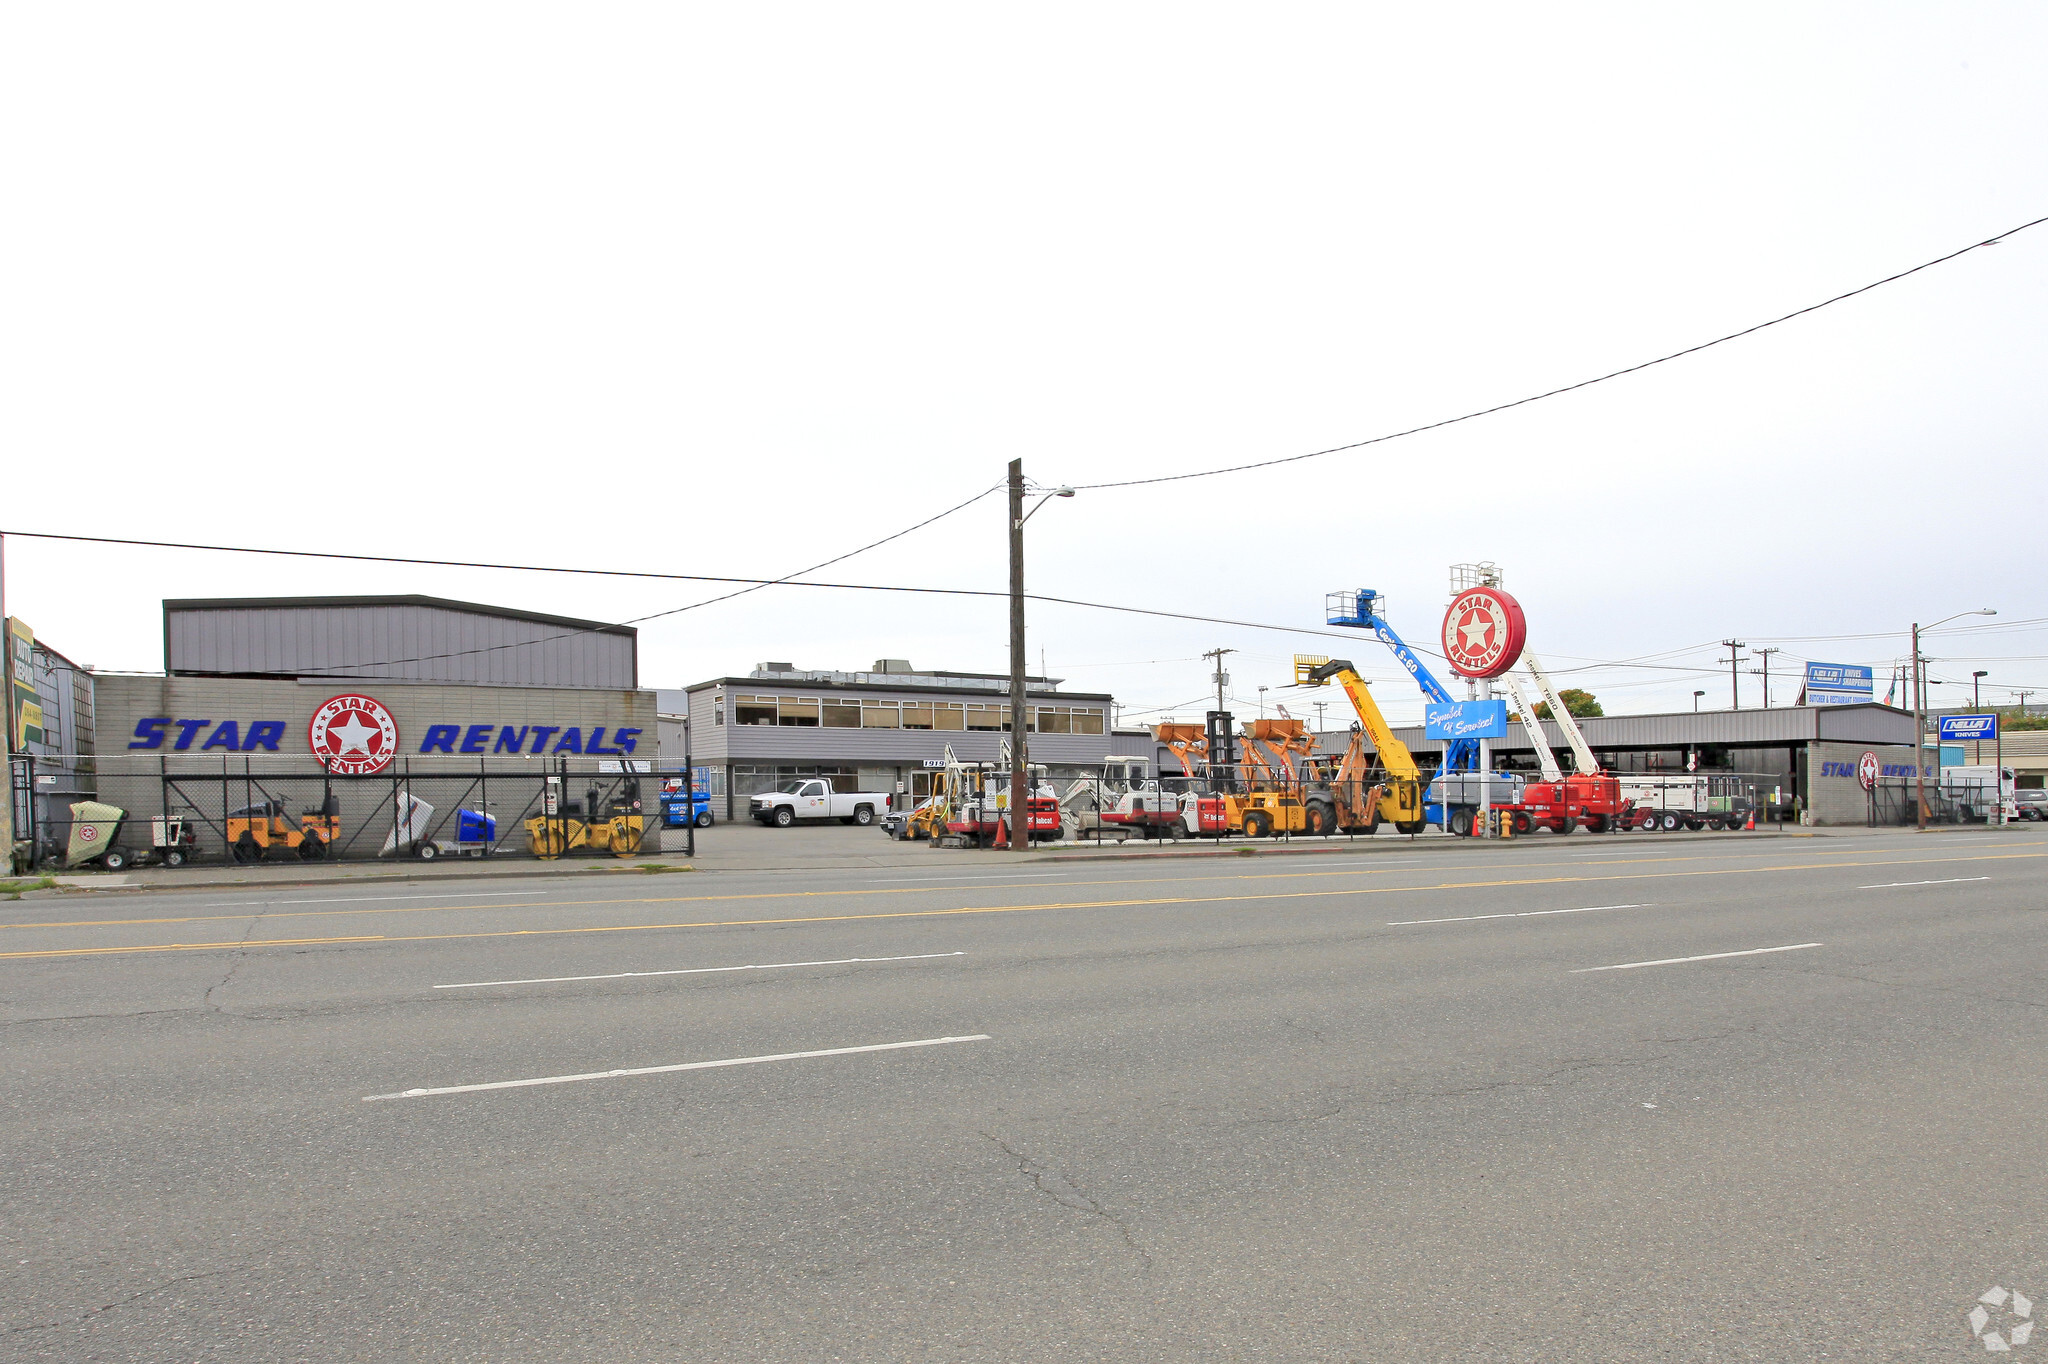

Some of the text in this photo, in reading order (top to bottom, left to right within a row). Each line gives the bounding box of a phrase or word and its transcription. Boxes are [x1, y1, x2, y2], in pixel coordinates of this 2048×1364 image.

[1458, 596, 1493, 614] STAR
[1379, 627, 1418, 673] Genie S-60
[1450, 642, 1501, 668] RENTALS
[327, 698, 378, 715] STAR
[1510, 691, 1526, 715] Snorkel
[1428, 704, 1463, 727] Symbol
[1949, 720, 1985, 730] NELLA
[127, 717, 287, 751] STAR
[419, 724, 643, 754] RENTALS
[316, 744, 392, 774] RENTALS
[1820, 761, 1933, 777] STAR RENTS
